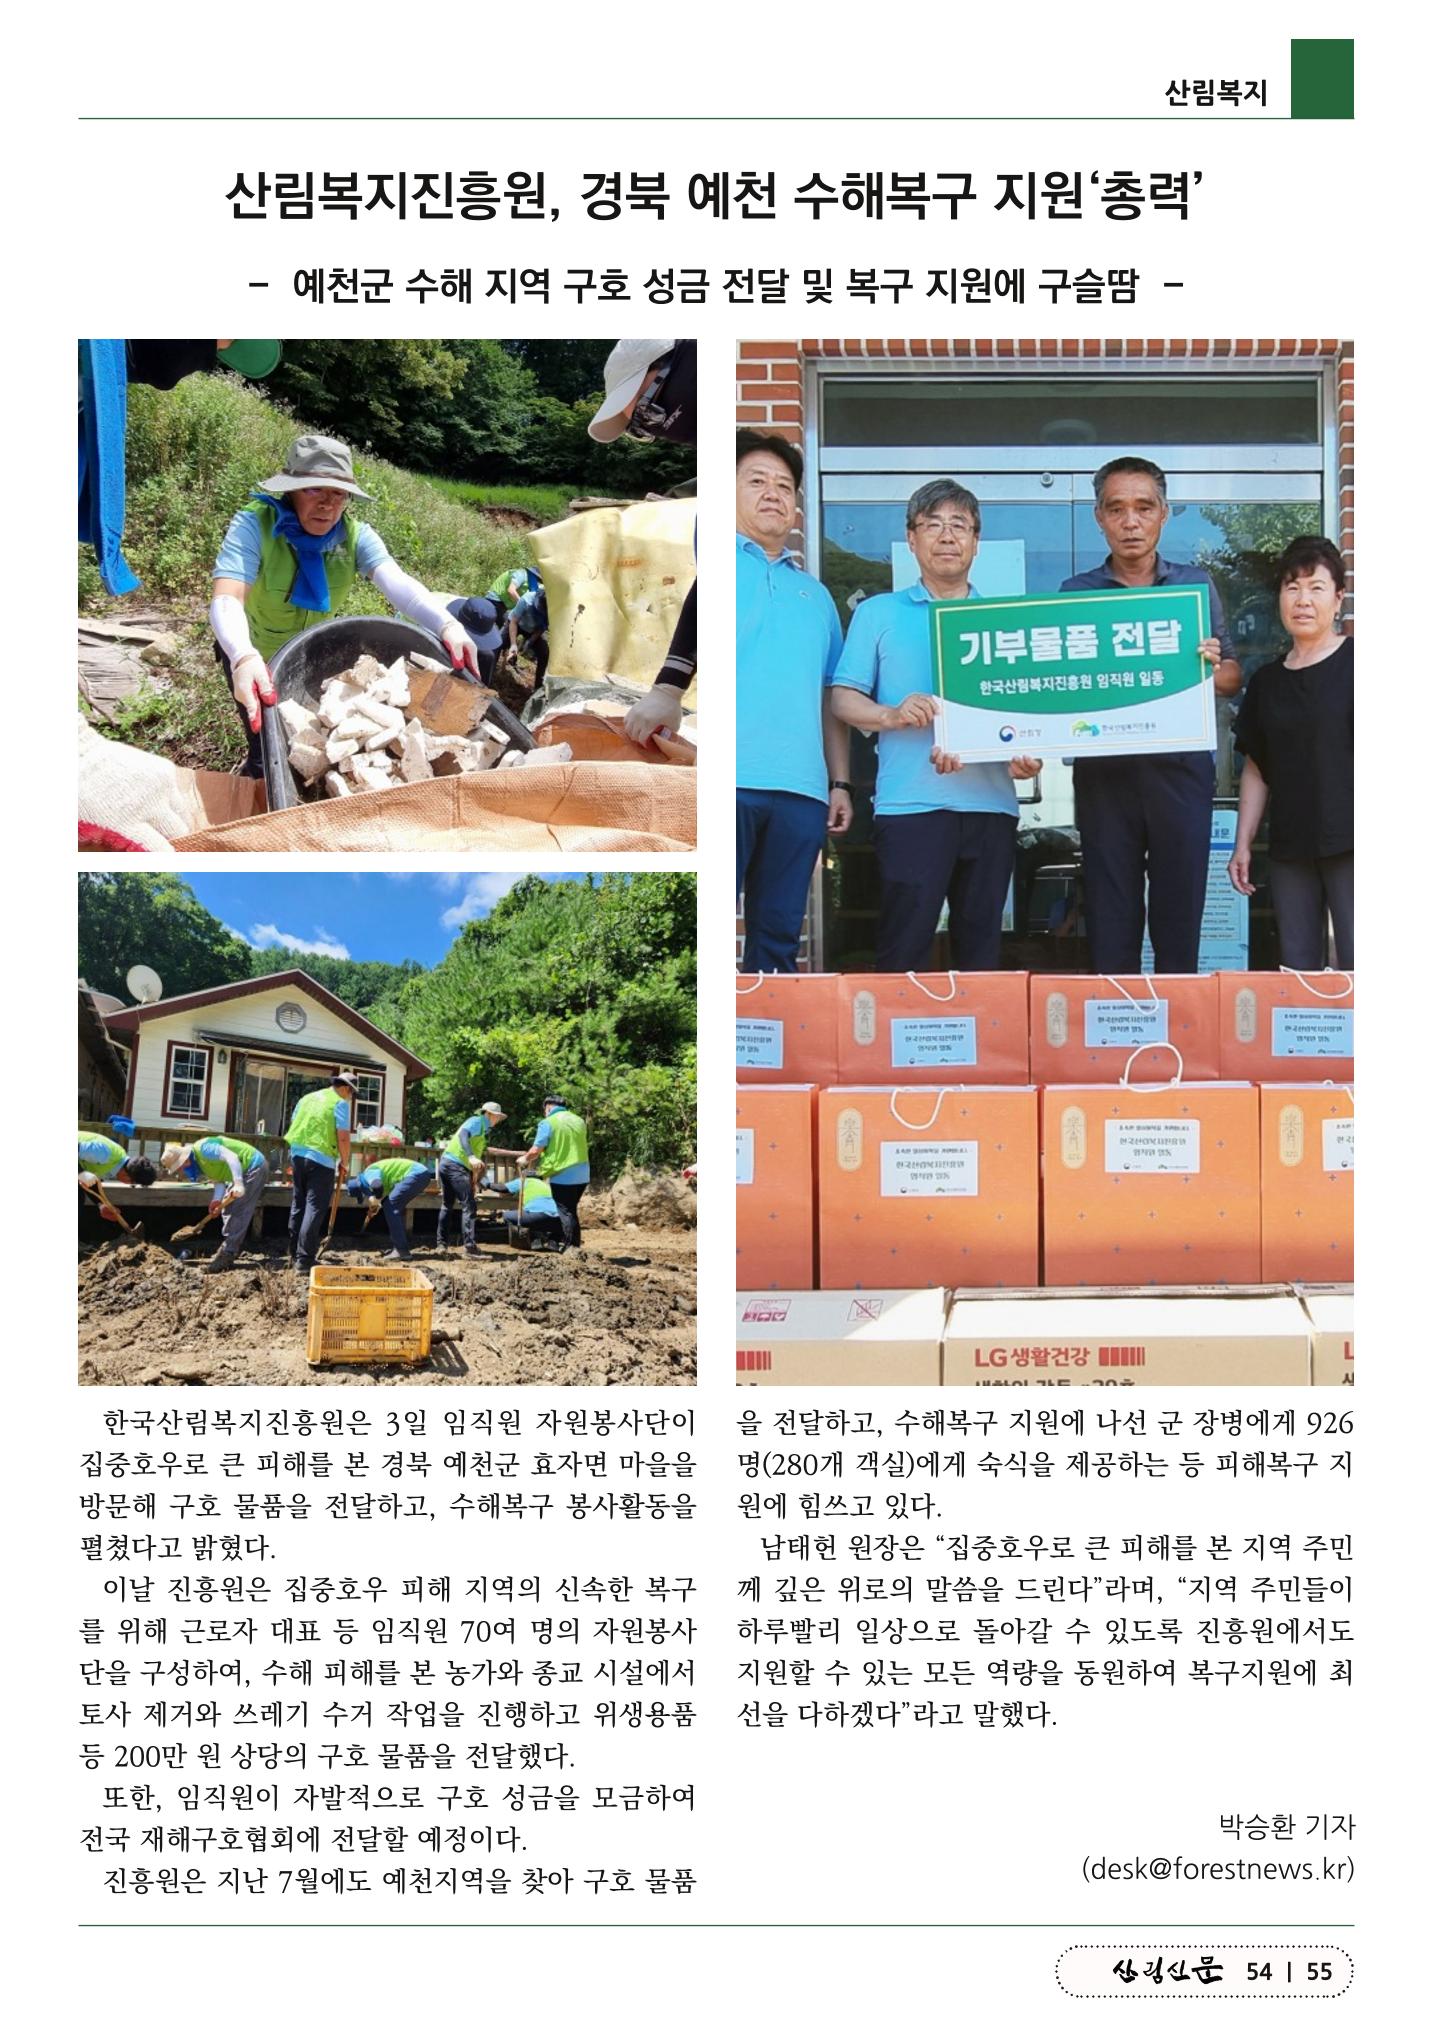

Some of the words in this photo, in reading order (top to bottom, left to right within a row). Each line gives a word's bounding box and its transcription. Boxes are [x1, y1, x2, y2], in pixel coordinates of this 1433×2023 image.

[1165, 80, 1266, 106] 산림복지
[226, 171, 559, 222] 산림복지진흥원,
[581, 172, 670, 220] 경북
[689, 172, 775, 219] 예천
[795, 172, 976, 220] 수해복구
[294, 268, 393, 304] 예천군
[406, 269, 471, 304] 수해
[485, 268, 549, 304] 지역
[564, 269, 630, 304] 구호
[643, 268, 709, 304] 성금
[723, 268, 789, 303] 전달
[804, 269, 832, 304] 및
[847, 269, 913, 304] 복구
[926, 268, 1024, 304] 지원에
[1039, 268, 1140, 304] 구슬땀
[959, 623, 1099, 665] 기부물품
[1112, 619, 1182, 657] 전달
[979, 673, 1092, 695] 한국산림복지진흥원
[1096, 671, 1135, 689] 임직원
[1139, 670, 1164, 686] 일동
[104, 1409, 372, 1436] 한국산림복지진흥원은
[387, 1410, 426, 1436] 3일
[444, 1409, 521, 1436] 임직원
[536, 1409, 693, 1436] 자원봉사단이
[737, 1410, 762, 1435] 을
[774, 1410, 882, 1437] 전달하고,
[895, 1410, 997, 1436] 수해복구
[1010, 1409, 1083, 1436] 지원에
[1097, 1410, 1146, 1436] 나선
[1158, 1412, 1183, 1435] 군
[1193, 1410, 1294, 1436] 장병에게
[1308, 1411, 1353, 1435] 926
[80, 1451, 208, 1478] 집중호우로
[220, 1453, 244, 1477] 큰
[257, 1451, 333, 1478] 피해를
[344, 1452, 369, 1477] 본
[382, 1451, 432, 1478] 경북
[444, 1451, 520, 1478] 예천군
[531, 1451, 607, 1478] 효자면
[620, 1451, 696, 1478] 마을을
[738, 1451, 842, 1478] 명(280개
[857, 1451, 964, 1478] 객실)에게
[977, 1451, 1055, 1477] 숙식을
[1066, 1451, 1168, 1478] 제공하는
[1179, 1452, 1204, 1478] 등
[1216, 1451, 1318, 1478] 피해복구
[1330, 1451, 1351, 1478] 지
[80, 1493, 155, 1519] 방문해
[170, 1494, 221, 1519] 구호
[234, 1494, 311, 1519] 물품을
[326, 1493, 434, 1521] 전달하고,
[450, 1493, 553, 1519] 수해복구
[567, 1493, 696, 1519] 봉사활동을
[81, 1534, 182, 1561] 펼쳤다고
[192, 1535, 275, 1561] 밝혔다.
[761, 1535, 836, 1561] 남태헌
[849, 1535, 925, 1561] 원장은
[937, 1535, 1074, 1561] “집중호우로
[1085, 1537, 1110, 1560] 큰
[1121, 1535, 1197, 1561] 피해를
[1207, 1535, 1232, 1560] 본
[1243, 1535, 1289, 1561] 지역
[1303, 1535, 1352, 1561] 주민
[104, 1576, 155, 1602] 이날
[168, 1576, 271, 1603] 진흥원은
[285, 1576, 387, 1603] 집중호우
[402, 1576, 450, 1603] 피해
[466, 1576, 539, 1603] 지역의
[556, 1576, 633, 1602] 신속한
[645, 1577, 696, 1602] 복구
[738, 1576, 760, 1602] 께
[775, 1576, 825, 1602] 깊은
[838, 1576, 911, 1603] 위로의
[927, 1576, 1004, 1602] 말씀을
[1016, 1576, 1162, 1604] 드린다”라며,
[1179, 1576, 1235, 1603] “지역
[1251, 1576, 1351, 1603] 주민들이
[738, 1618, 839, 1644] 하루빨리
[857, 1618, 960, 1644] 일상으로
[973, 1618, 1052, 1644] 돌아갈
[1065, 1618, 1090, 1644] 수
[1106, 1618, 1182, 1644] 있도록
[1197, 1618, 1354, 1644] 진흥원에서도
[80, 1660, 130, 1685] 단을
[141, 1660, 250, 1687] 구성하여,
[262, 1659, 311, 1686] 수해
[325, 1660, 400, 1686] 피해를
[410, 1660, 435, 1685] 본
[445, 1660, 523, 1686] 농가와
[532, 1661, 583, 1686] 종교
[594, 1659, 693, 1686] 시설에서
[738, 1659, 814, 1686] 지원할
[825, 1660, 850, 1686] 수
[864, 1660, 912, 1686] 있는
[924, 1661, 975, 1685] 모든
[988, 1659, 1063, 1686] 역량을
[1075, 1660, 1174, 1686] 동원하여
[1189, 1660, 1315, 1686] 복구지원에
[1330, 1660, 1351, 1686] 최
[79, 1701, 131, 1727] 토사
[144, 1701, 221, 1728] 제거와
[233, 1701, 307, 1728] 쓰레기
[323, 1701, 371, 1728] 수거
[387, 1701, 464, 1727] 작업을
[478, 1701, 580, 1728] 진행하고
[594, 1701, 696, 1728] 위생용품
[738, 1701, 788, 1727] 선을
[799, 1701, 963, 1728] 다하겠다”라고
[974, 1701, 1056, 1728] 말했다.
[79, 1744, 104, 1769] 등
[115, 1743, 187, 1768] 200만
[198, 1743, 221, 1768] 원
[231, 1743, 305, 1769] 상당의
[318, 1744, 369, 1769] 구호
[378, 1744, 455, 1769] 물품을
[466, 1743, 574, 1769] 전달했다.
[103, 1785, 161, 1812] 또한,
[178, 1785, 277, 1811] 임직원이
[294, 1785, 424, 1811] 자발적으로
[437, 1786, 488, 1811] 구호
[503, 1785, 579, 1811] 성금을
[593, 1785, 693, 1811] 모금하여
[80, 1826, 130, 1852] 전국
[141, 1826, 319, 1853] 재해구호협회에
[332, 1826, 408, 1852] 전달할
[418, 1826, 526, 1853] 예정이다.
[1221, 1814, 1296, 1840] 박승환
[1307, 1814, 1356, 1840] 기자
[104, 1868, 206, 1894] 진흥원은
[218, 1868, 268, 1894] 지난
[279, 1868, 371, 1894] 7월에도
[383, 1868, 511, 1894] 예천지역을
[522, 1868, 574, 1894] 찾아
[584, 1869, 635, 1894] 구호
[645, 1869, 696, 1894] 물품
[1083, 1856, 1354, 1883] (desk@forestnews.kr)
[1113, 1956, 1223, 1984] 산림신문
[1248, 1963, 1272, 1980] 54
[1308, 1963, 1332, 1980] 55
